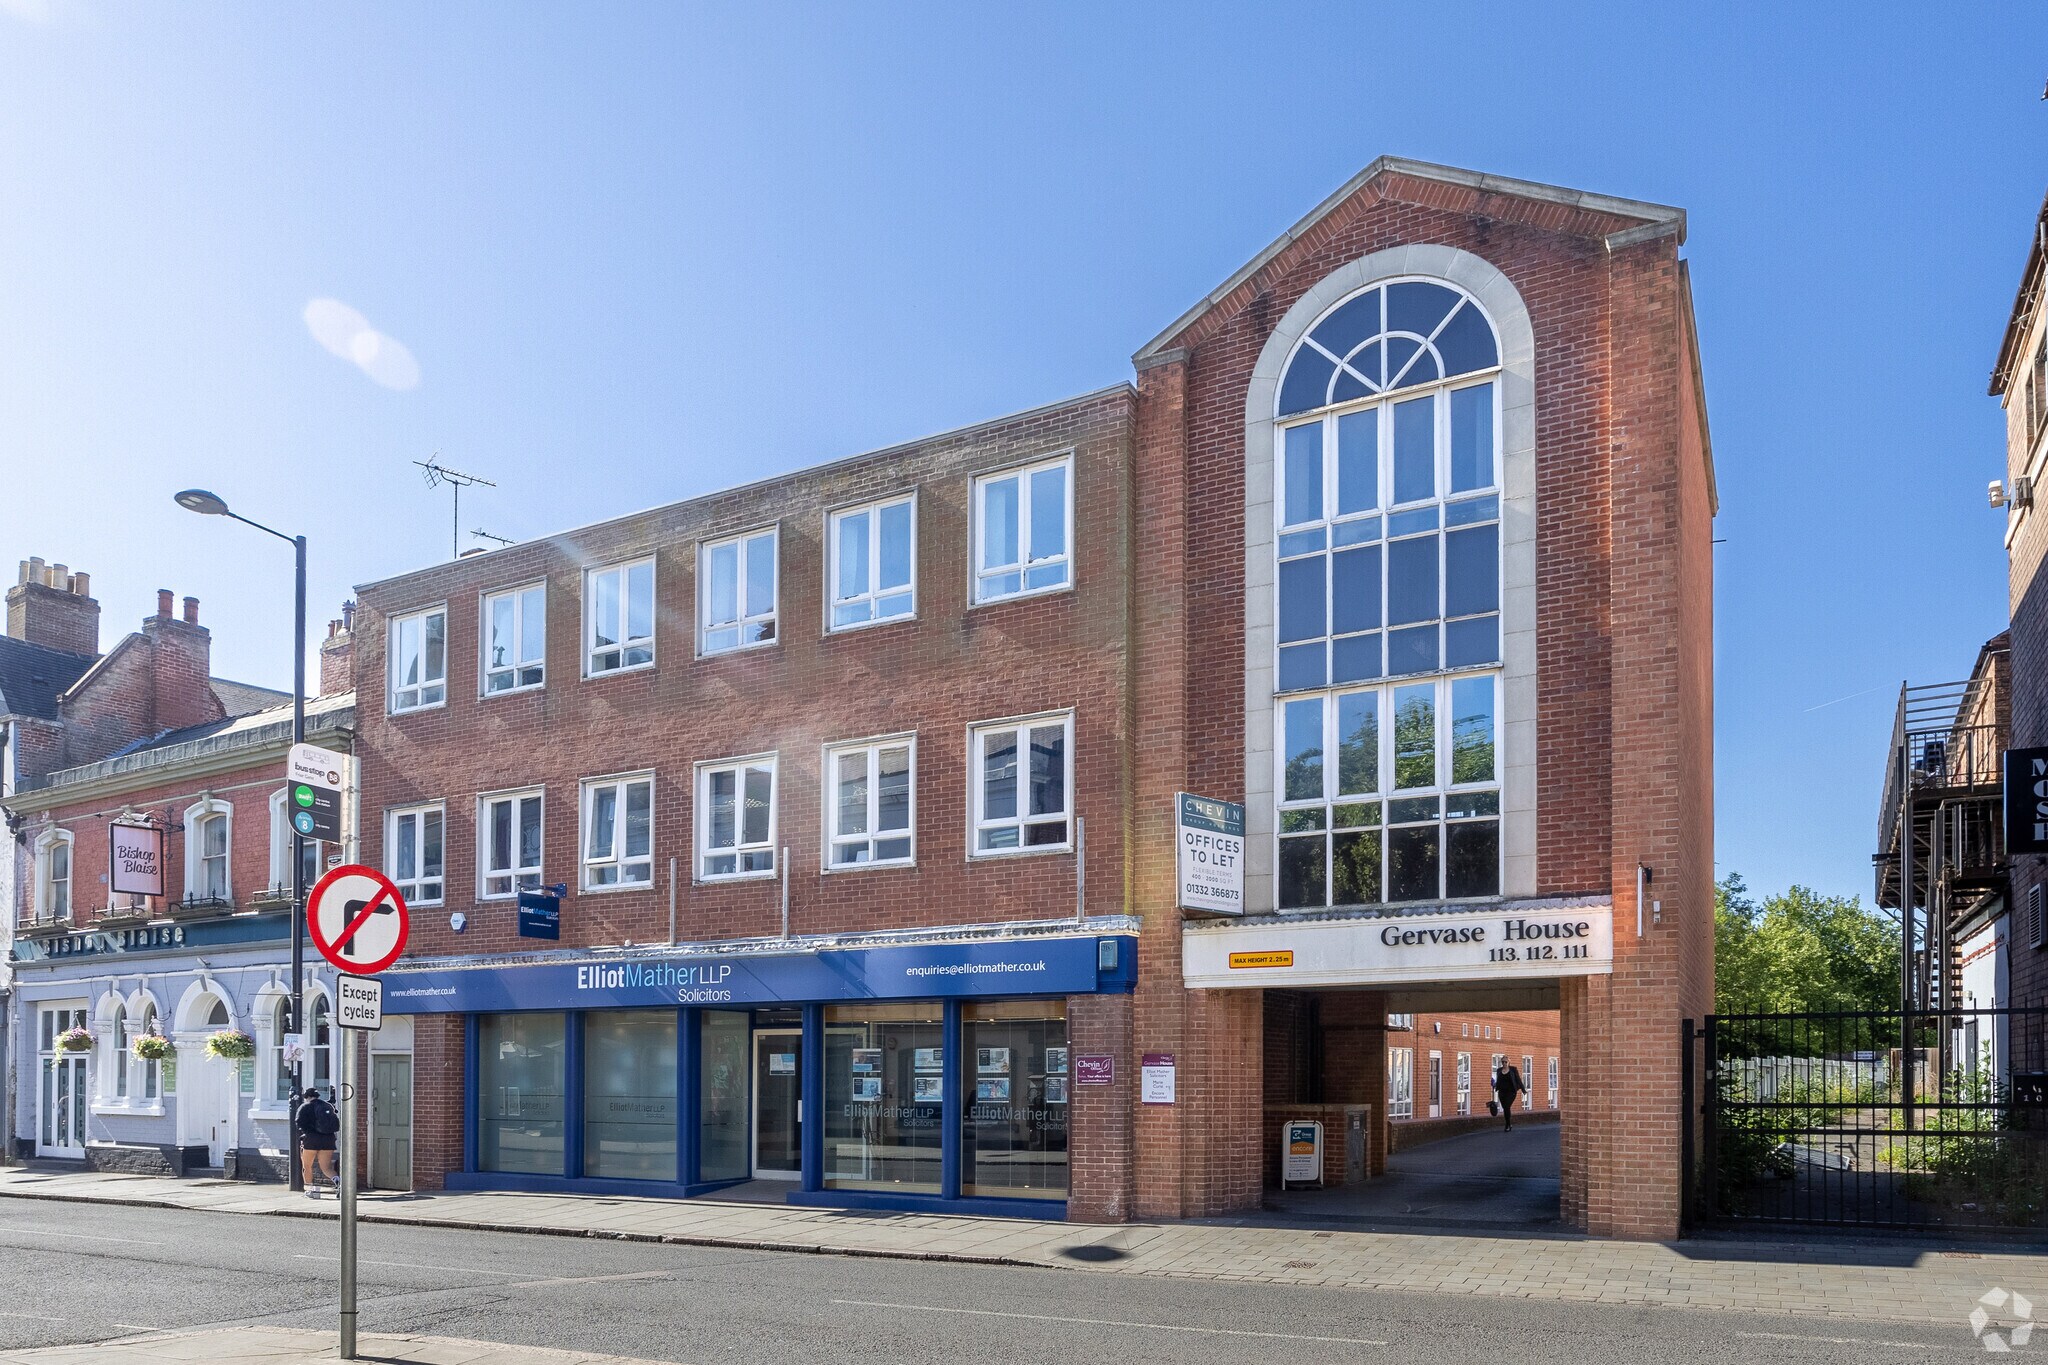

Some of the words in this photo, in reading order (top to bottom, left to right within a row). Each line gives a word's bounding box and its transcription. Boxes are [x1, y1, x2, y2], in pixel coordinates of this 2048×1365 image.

[295, 762, 309, 773] bus
[309, 766, 325, 778] stop
[1185, 801, 1240, 821] CHEVIN
[302, 820, 308, 830] 8
[1186, 833, 1240, 853] OFFICES
[117, 846, 155, 865] Bishop
[1191, 849, 1207, 863] TO
[1212, 853, 1235, 868] LET
[124, 860, 158, 876] Blaise
[1193, 866, 1215, 876] FLEXIBLE
[1216, 870, 1233, 878] TERMS
[1186, 883, 1209, 896] 01332
[1211, 887, 1239, 900] 366873
[118, 927, 184, 947] Blaise
[1381, 926, 1485, 946] Gervase
[1504, 919, 1590, 941] House
[1489, 948, 1520, 962] 113.
[1526, 946, 1558, 961] 112.
[578, 963, 697, 989] ElliotMather
[700, 965, 731, 984] LLP
[906, 960, 1046, 977] enquiries@elliotmather.co.uk
[343, 983, 378, 1003] Except
[390, 986, 457, 998] www.elliotmather.co.uk
[678, 988, 731, 1002] Solicitors
[344, 1004, 375, 1020] cycles
[1078, 1060, 1100, 1068] Chevin
[844, 1104, 915, 1118] ElliotMather
[916, 1108, 934, 1118] LLP
[970, 1106, 1048, 1121] ElliotMather
[903, 1118, 934, 1128] Solicitors
